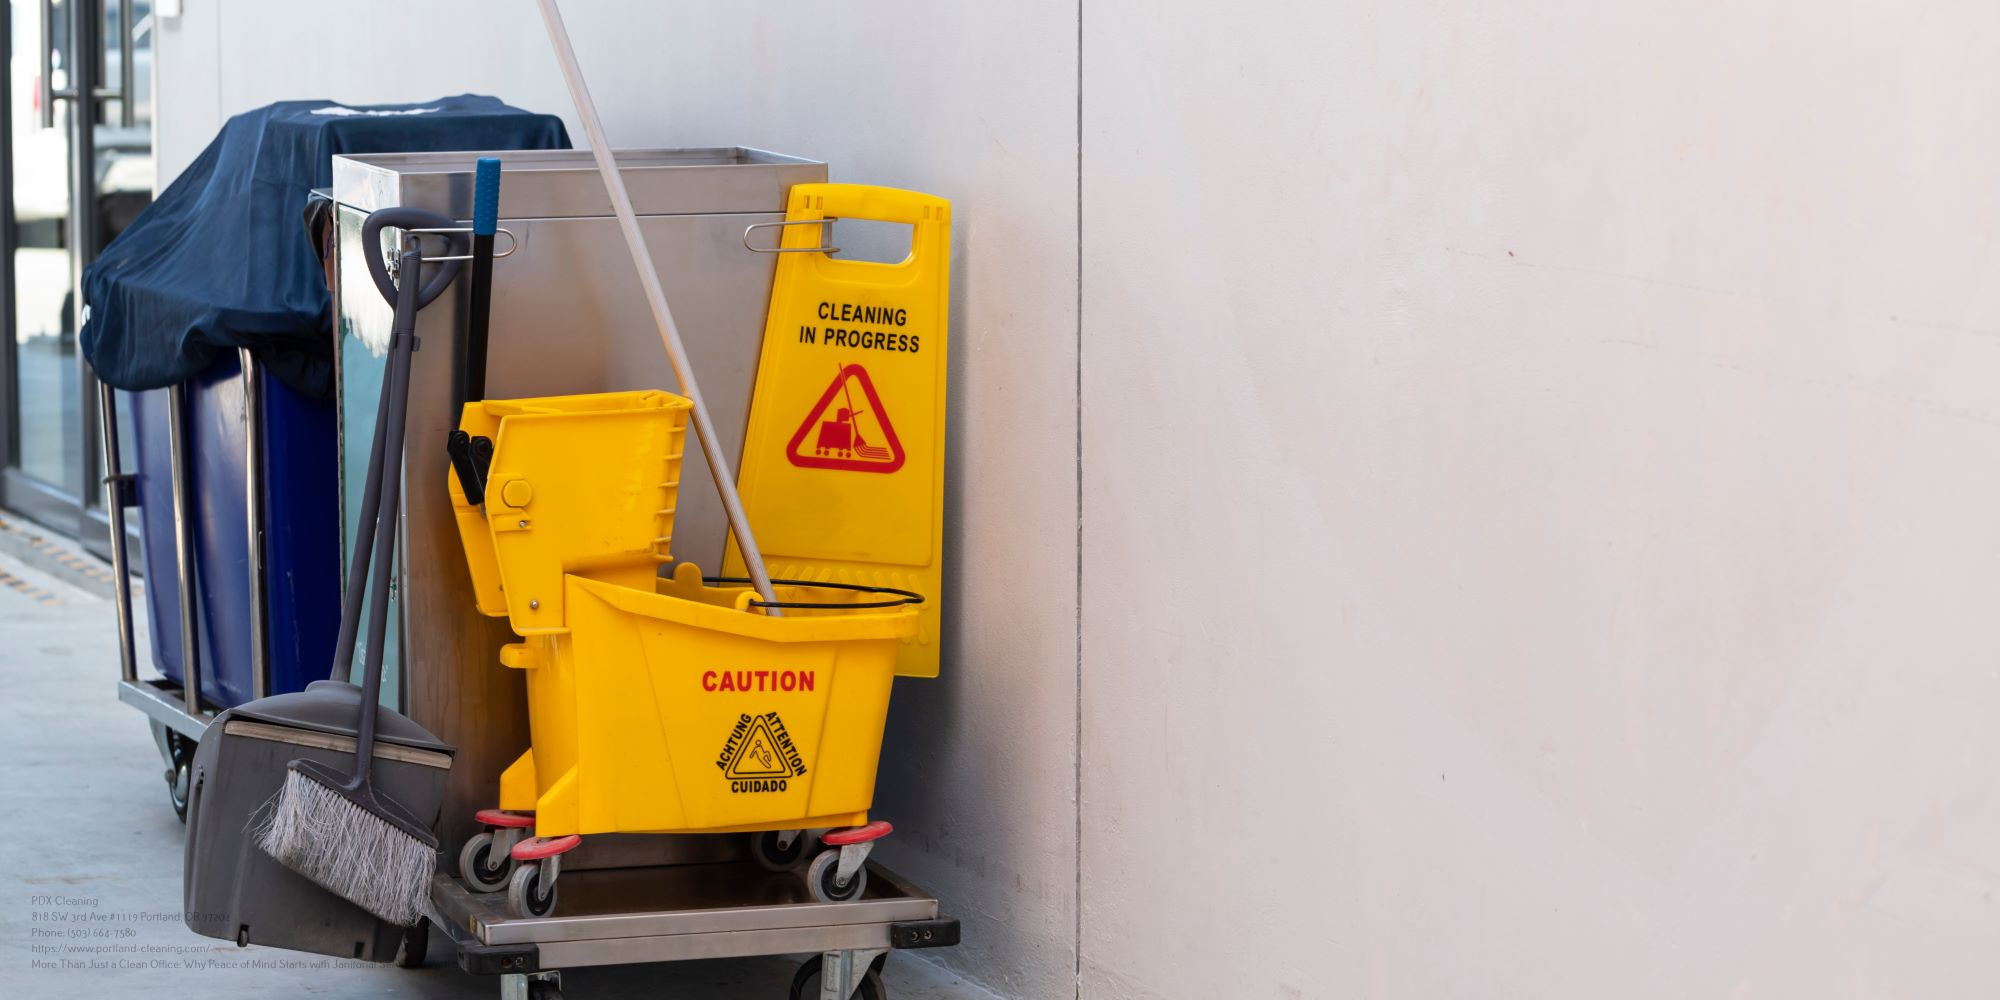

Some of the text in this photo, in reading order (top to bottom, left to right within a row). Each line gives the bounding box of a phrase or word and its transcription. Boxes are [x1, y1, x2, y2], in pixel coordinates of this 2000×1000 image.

[818, 302, 906, 326] CLEANING
[799, 326, 919, 353] IN PROGRESS
[702, 671, 814, 691] CAUTION
[716, 714, 751, 771] ACHTUNG
[766, 712, 807, 776] ATTENTION
[731, 780, 787, 793] CUIDADO
